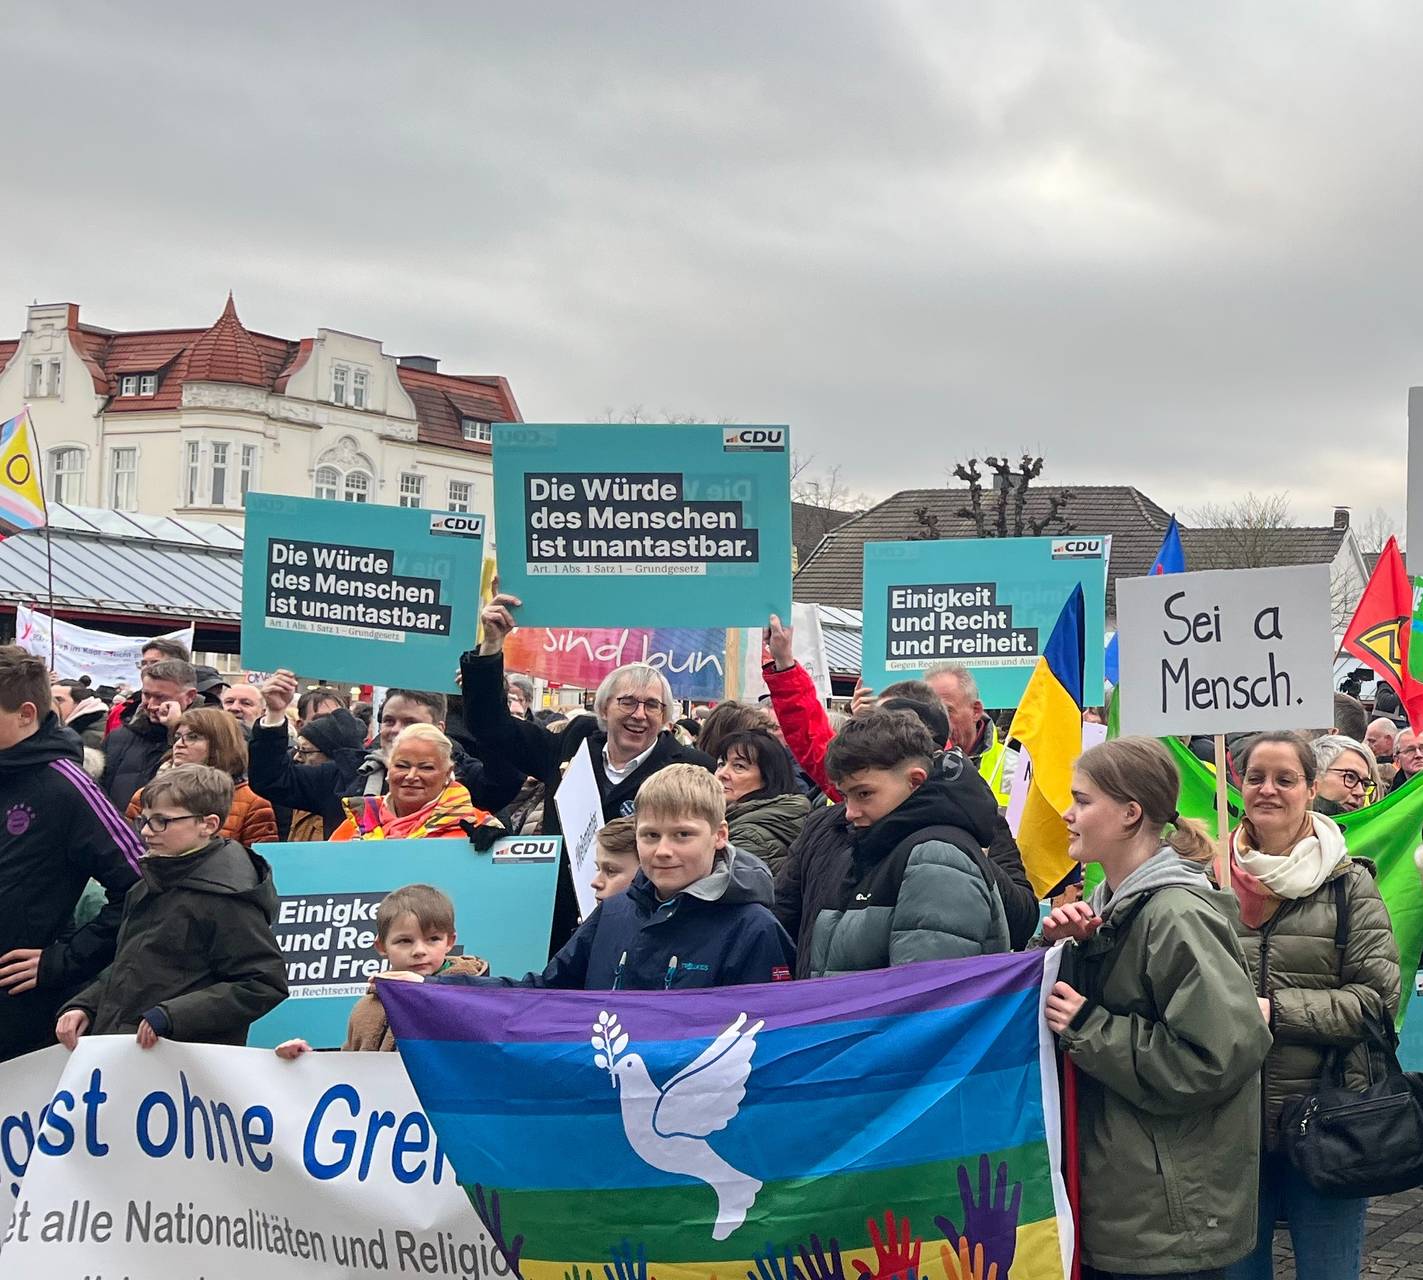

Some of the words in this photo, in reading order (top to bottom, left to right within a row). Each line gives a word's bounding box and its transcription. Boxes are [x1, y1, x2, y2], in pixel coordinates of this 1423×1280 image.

[740, 430, 782, 443] CDU
[530, 478, 576, 501] Die
[581, 478, 677, 501] Würde
[444, 518, 480, 532] CDU
[531, 507, 582, 529] des
[588, 507, 736, 529] Menschen
[532, 534, 566, 557] ist
[572, 534, 752, 557] unantastbar.
[1065, 541, 1100, 552] CDU
[272, 544, 308, 566] Die
[312, 548, 388, 574] Würde
[594, 565, 615, 573] Satz
[635, 565, 699, 575] Grundgesetz
[271, 569, 310, 591] des
[315, 573, 434, 604] Menschen
[892, 586, 990, 612] Einigkeit
[270, 592, 296, 614] ist
[302, 600, 445, 631] unantastbar.
[892, 612, 934, 632] und
[940, 610, 1007, 630] Recht
[1164, 591, 1221, 645] Sei
[1254, 606, 1283, 640] a
[348, 628, 400, 641] Grundgesetz
[891, 635, 934, 655] und
[940, 632, 1032, 654] Freiheit.
[642, 634, 727, 676] bun
[890, 660, 916, 669] Gegen
[1002, 657, 1017, 665] und
[1162, 652, 1303, 713] Mensch.
[510, 842, 554, 855] CDU
[278, 898, 379, 928] Einigke
[284, 956, 332, 981] nd
[136, 1070, 274, 1173] ohne
[40, 1200, 112, 1243] alle
[126, 1200, 326, 1264] Nationalitäten
[332, 1228, 388, 1270] und
